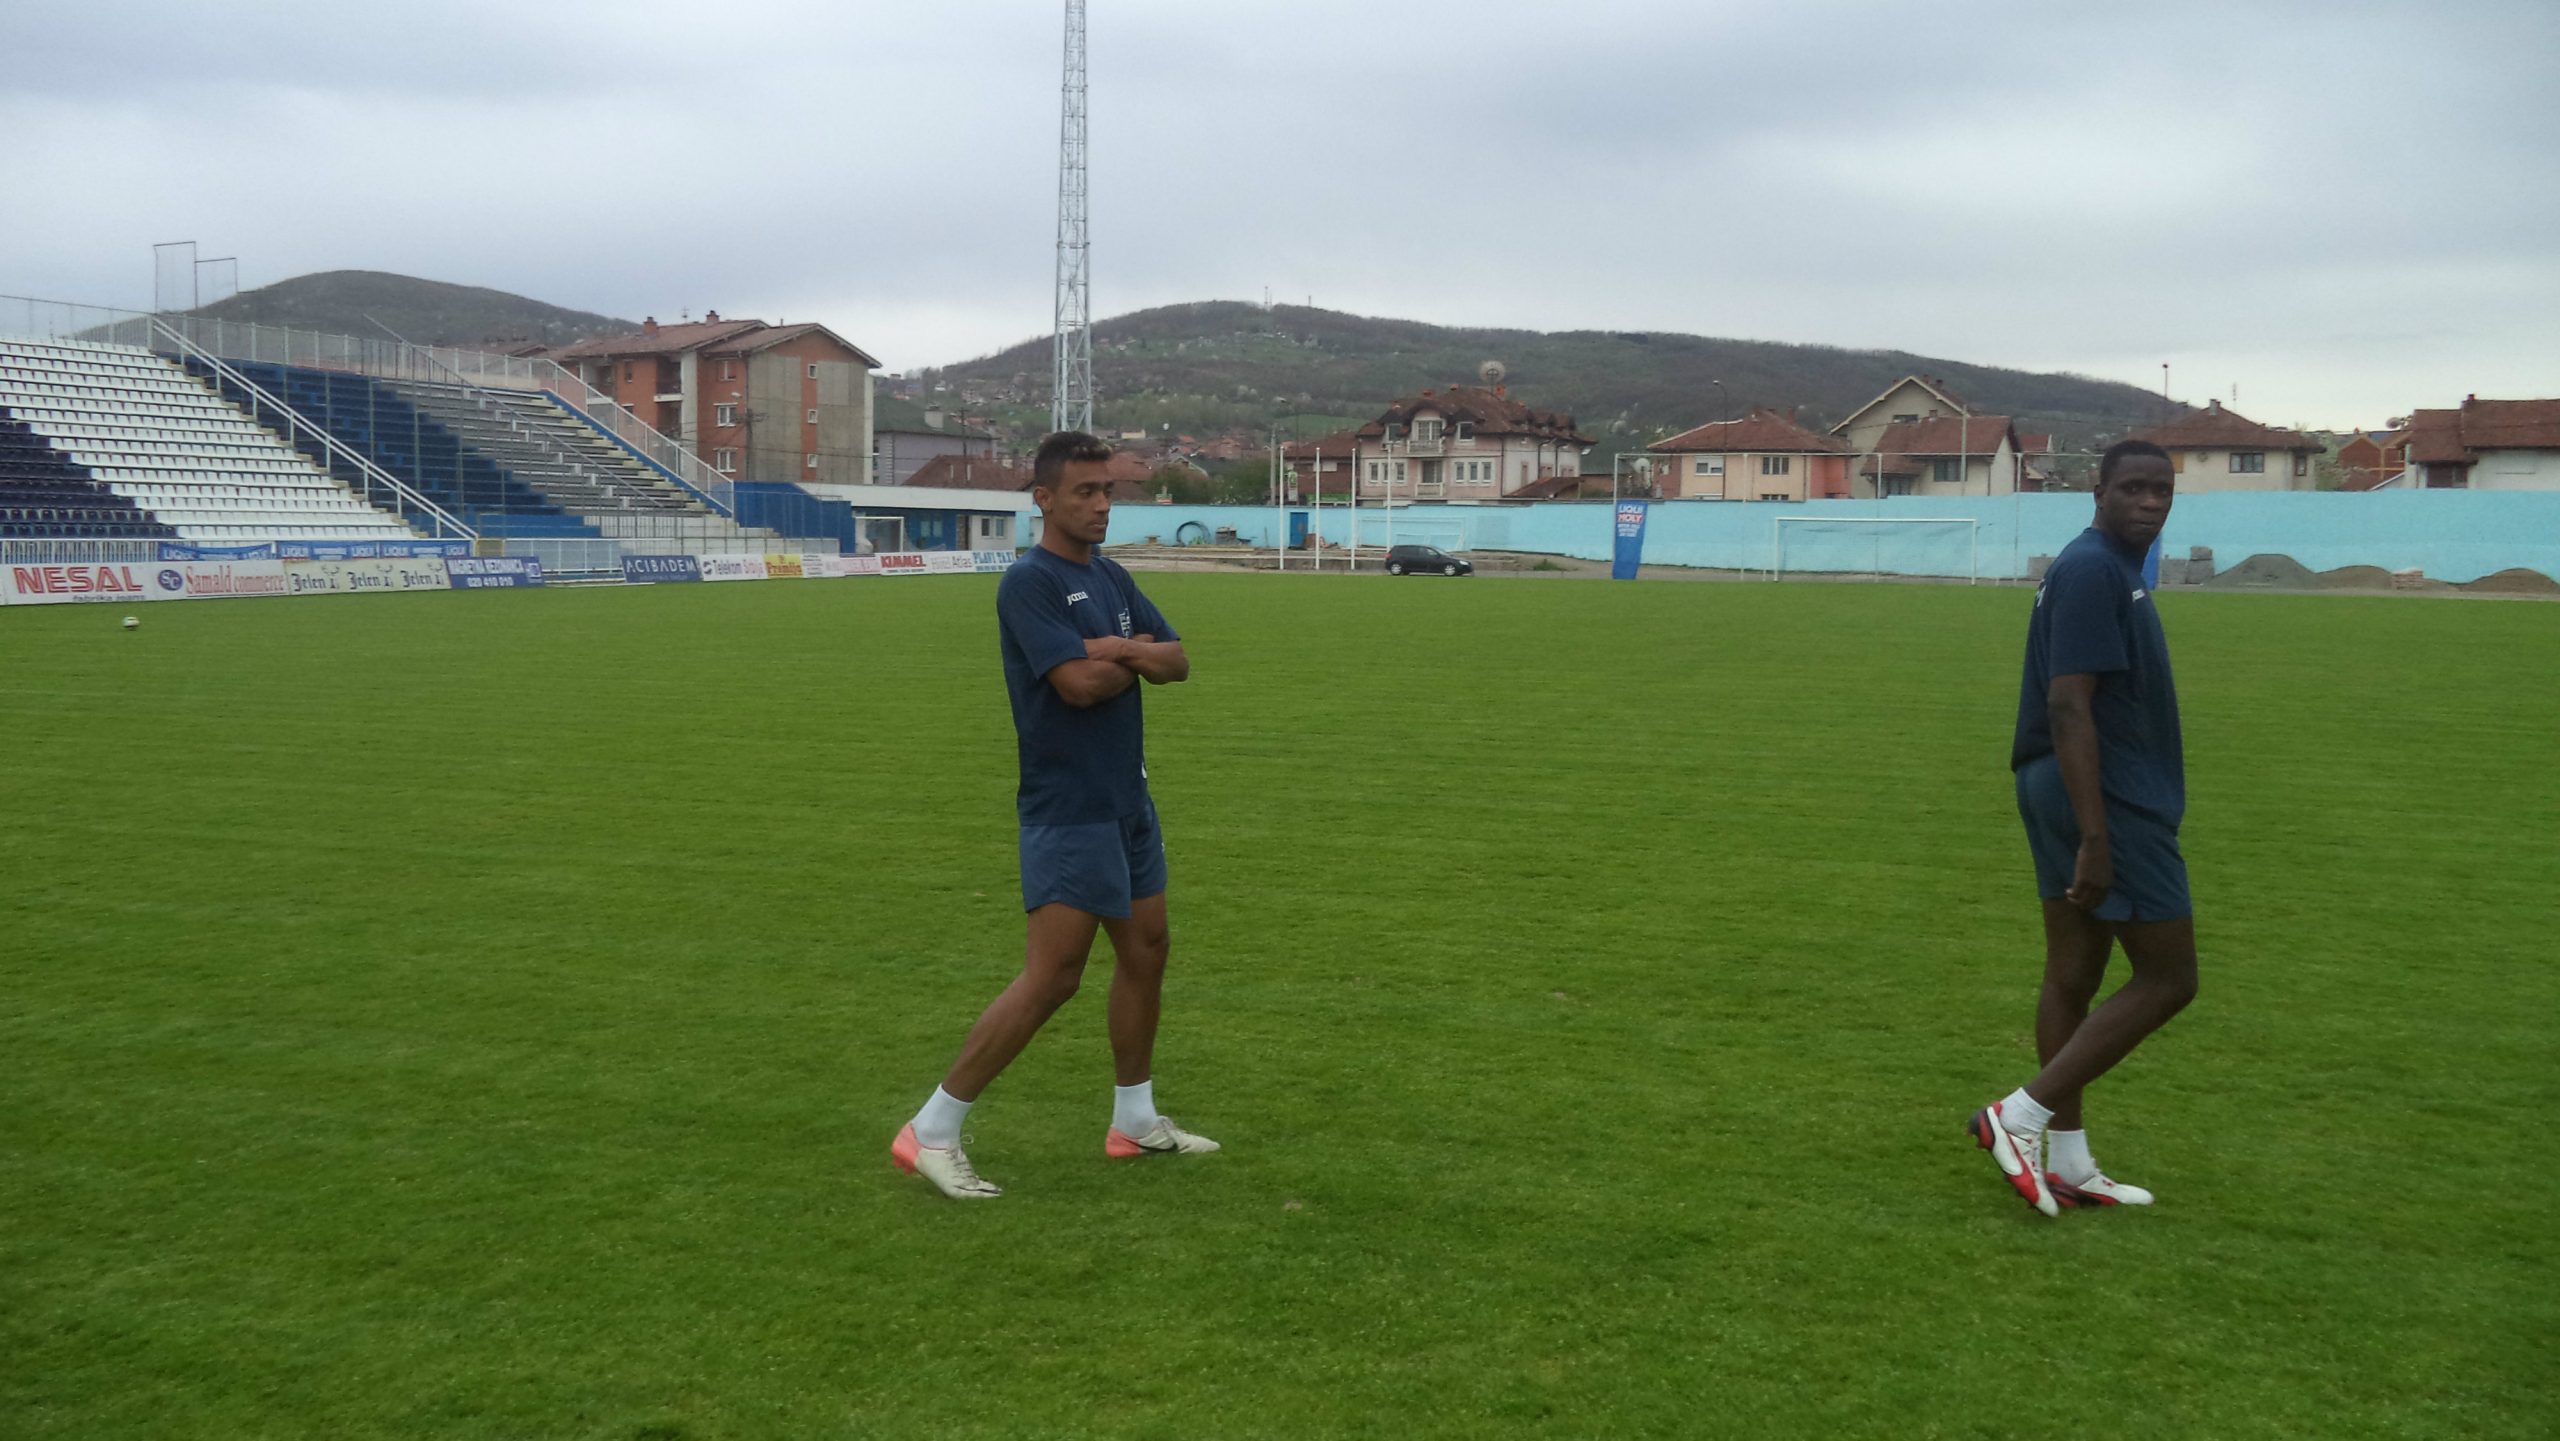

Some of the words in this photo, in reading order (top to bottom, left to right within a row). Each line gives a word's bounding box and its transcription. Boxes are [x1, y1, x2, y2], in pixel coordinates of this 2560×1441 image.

[1619, 504, 1643, 513] LIQUI
[1618, 514, 1643, 524] MOLY
[626, 559, 697, 573] ACIBADEM
[712, 559, 742, 575] Telekom
[13, 566, 143, 594] NESAL
[291, 573, 326, 592] Jelen
[347, 571, 381, 590] Jelen
[400, 570, 432, 588] Jelen
